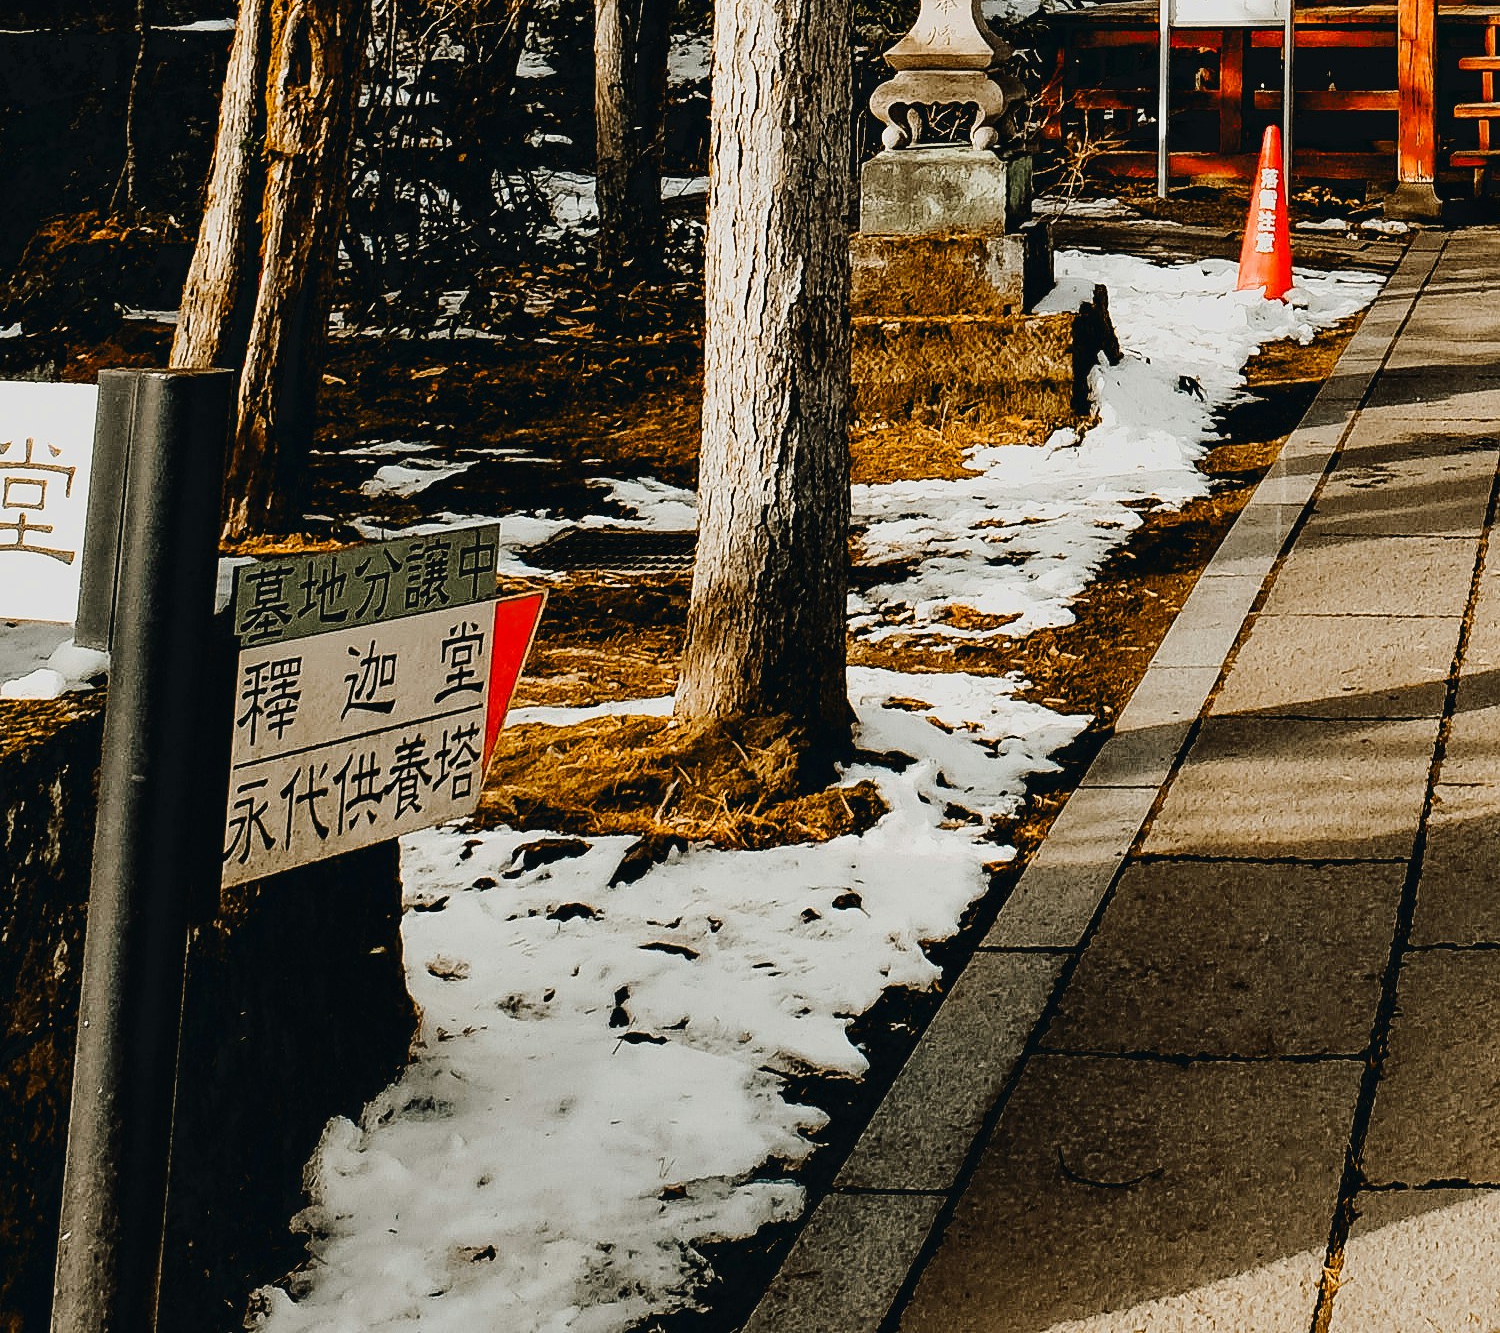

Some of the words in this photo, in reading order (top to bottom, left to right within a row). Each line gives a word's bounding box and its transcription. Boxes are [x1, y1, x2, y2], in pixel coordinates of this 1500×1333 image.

[0, 436, 77, 566] 堂
[236, 621, 485, 746] 釋迦堂
[222, 724, 482, 864] 永代供養塔
